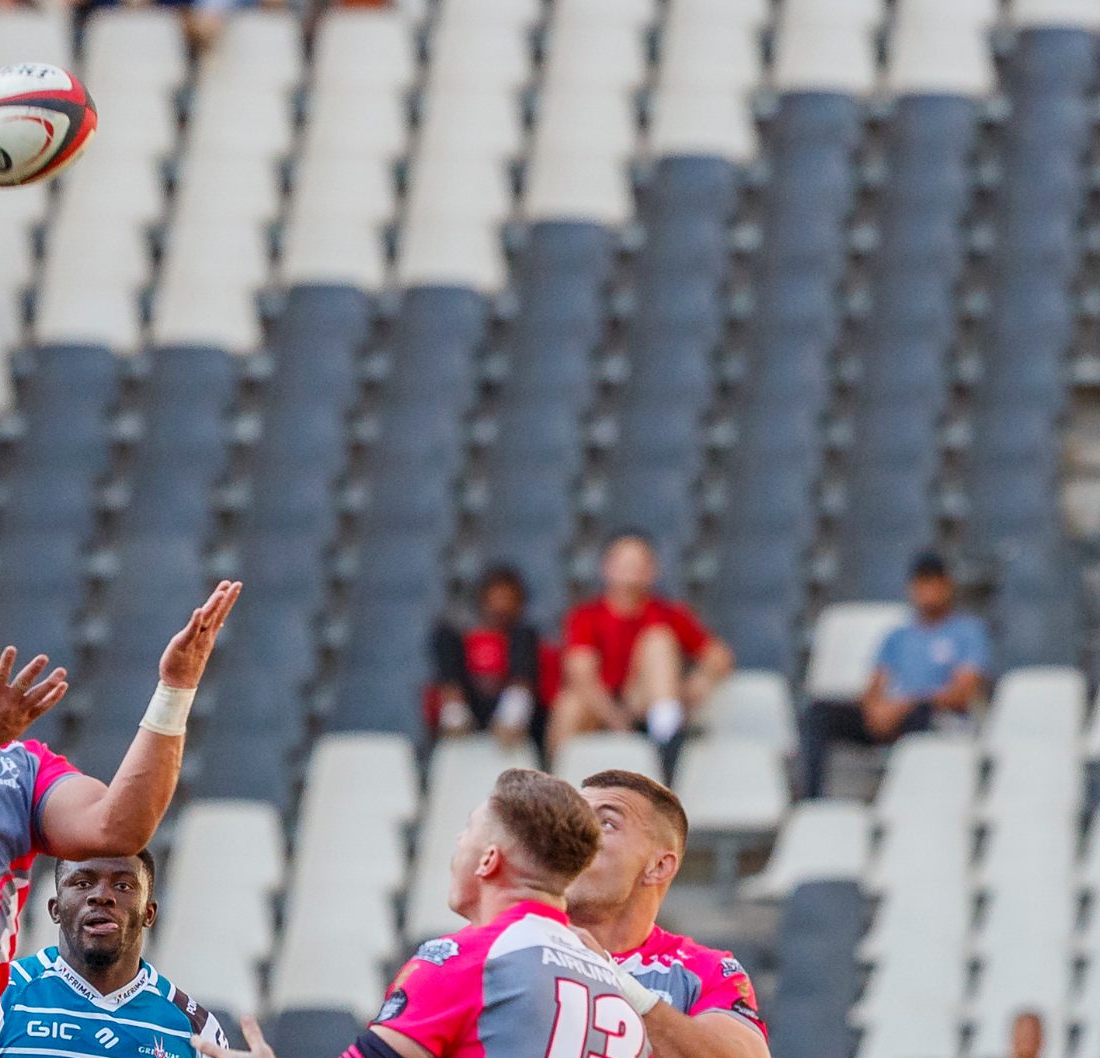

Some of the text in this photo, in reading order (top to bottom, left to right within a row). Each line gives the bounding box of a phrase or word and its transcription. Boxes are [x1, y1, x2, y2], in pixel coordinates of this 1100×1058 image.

[541, 947, 623, 989] AIRLIN
[64, 973, 97, 1001] AFRIMAT
[123, 974, 147, 999] AFRIMAT
[26, 1020, 81, 1041] GIC
